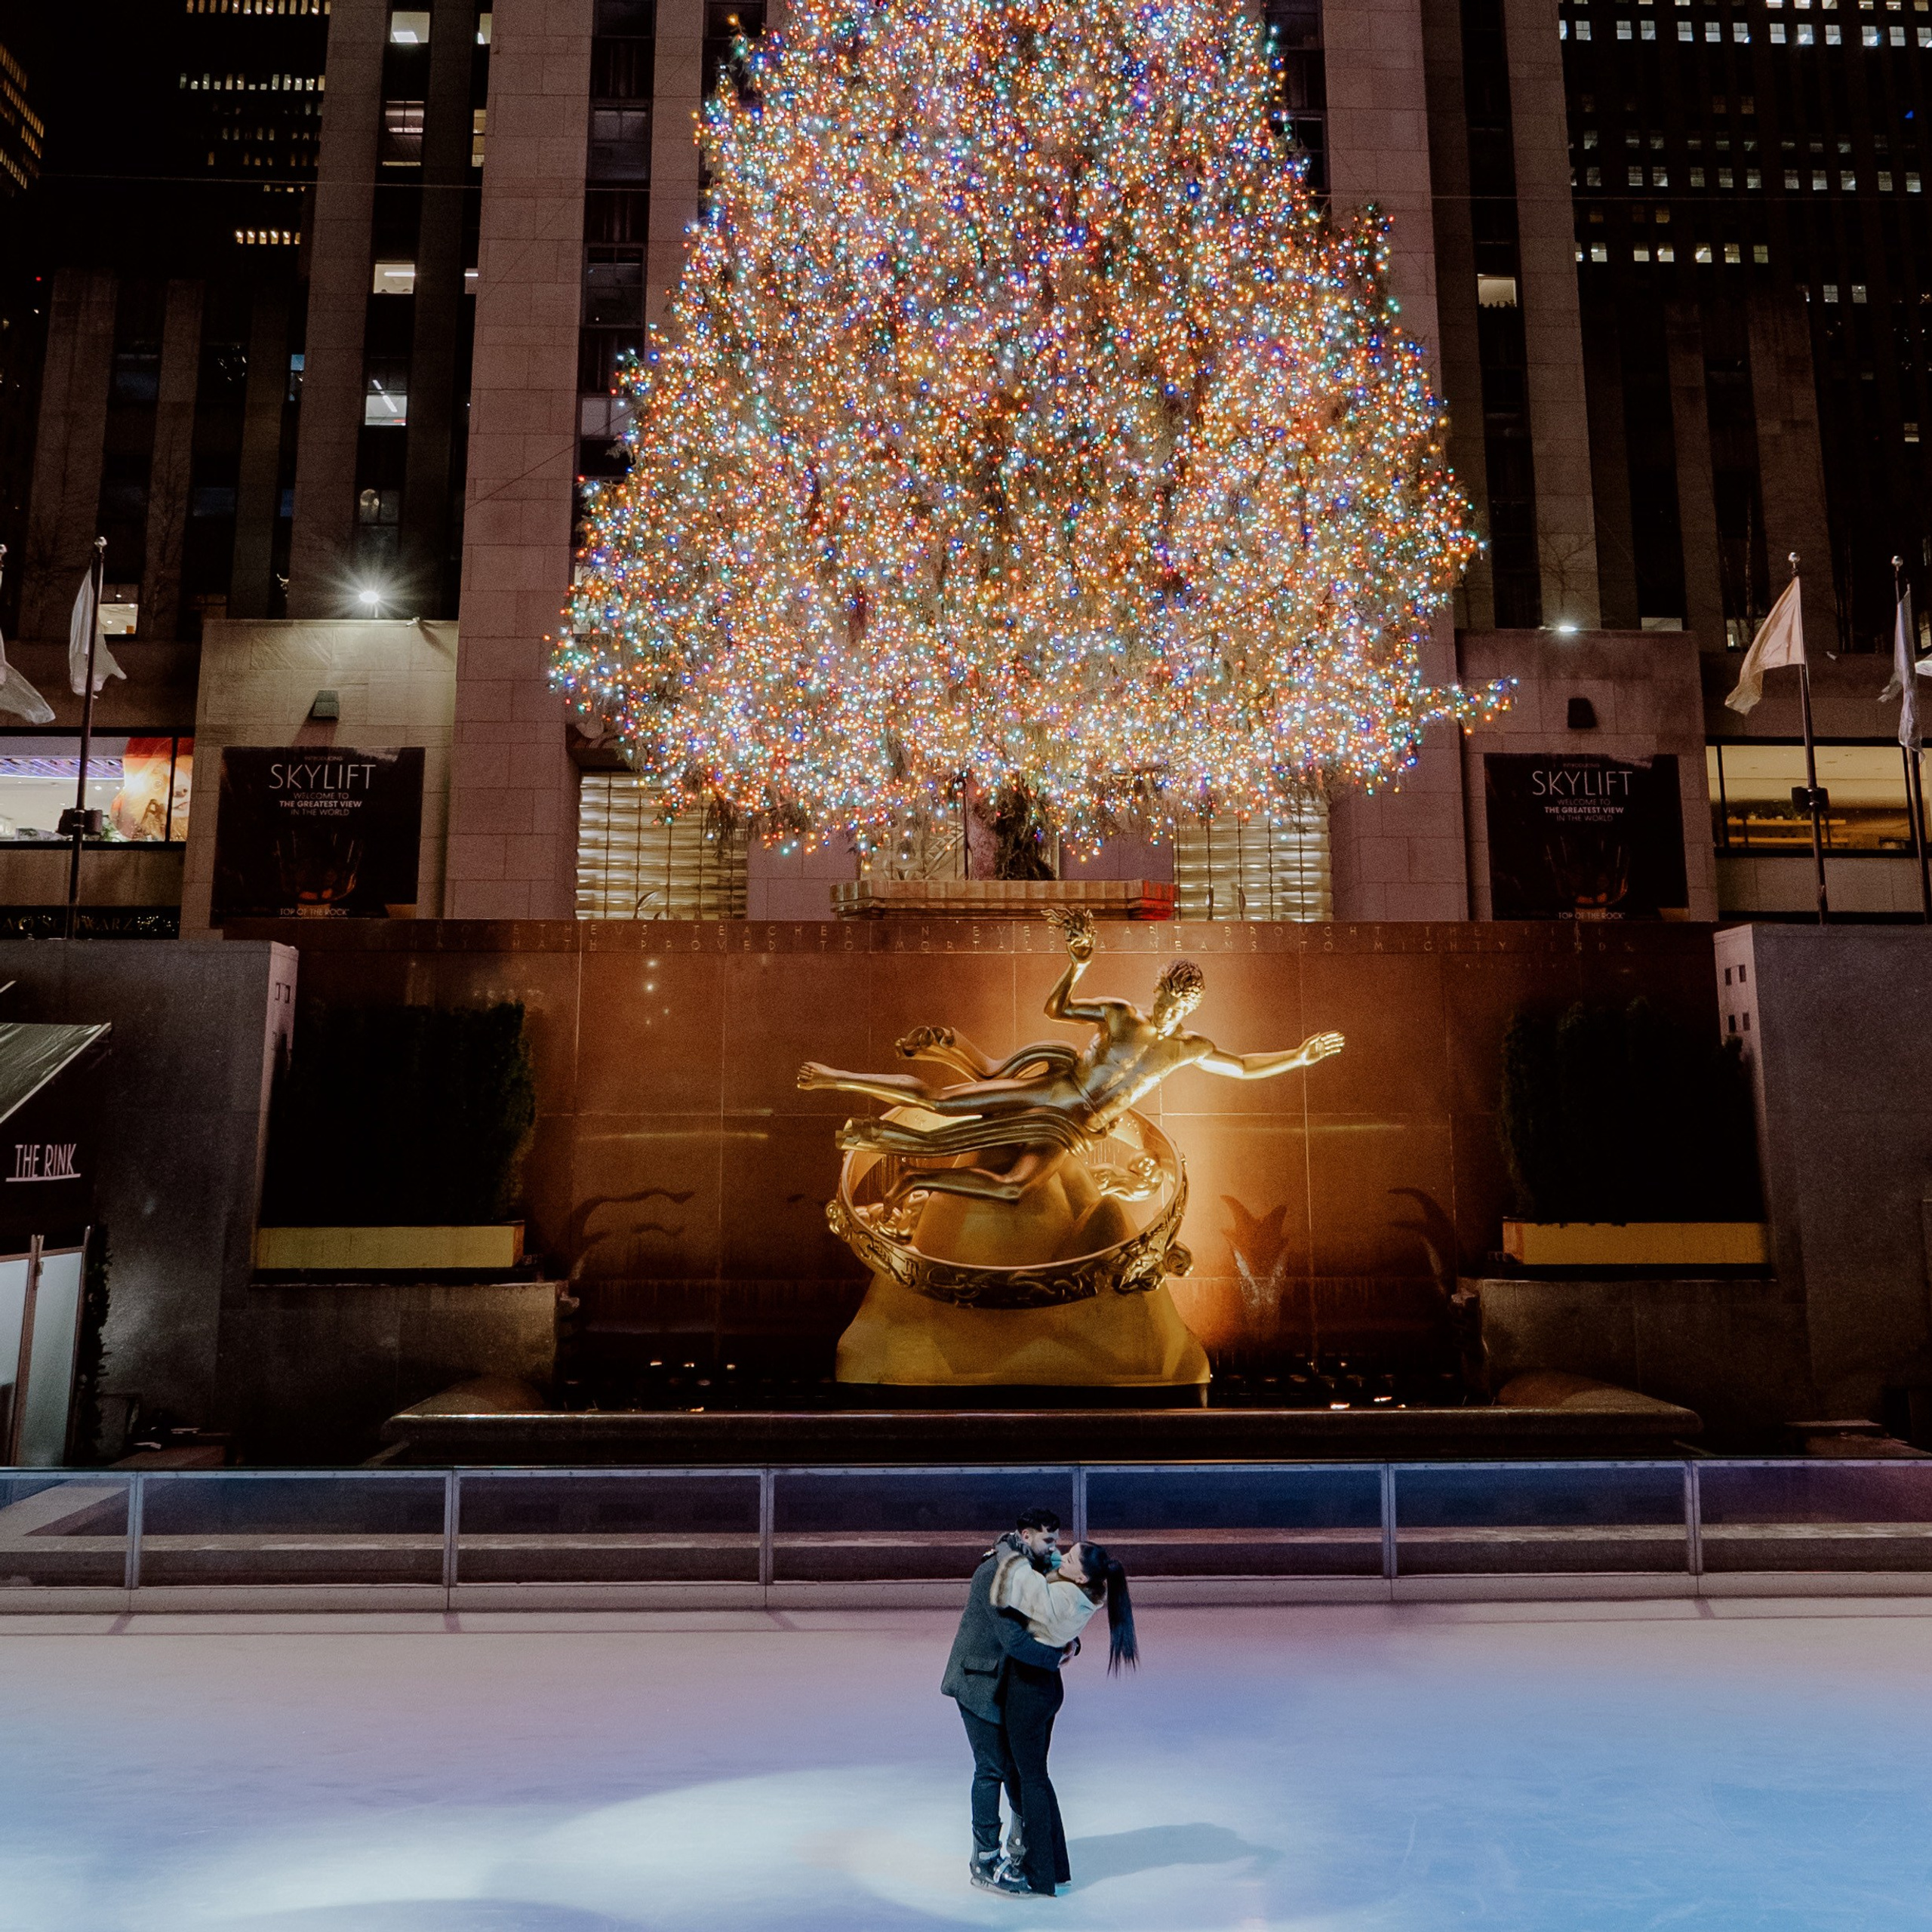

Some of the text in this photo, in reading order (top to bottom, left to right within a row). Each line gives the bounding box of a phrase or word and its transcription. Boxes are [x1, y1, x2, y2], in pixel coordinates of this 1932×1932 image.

[269, 764, 377, 789] SKYLIFT
[1532, 771, 1633, 795] SKYLIFT
[280, 908, 295, 916] TOP
[38, 916, 134, 931] SCWARZ
[693, 924, 853, 937] TEACHER
[898, 925, 930, 937] IN
[1124, 926, 1182, 937] ART
[641, 940, 776, 951] PROVED
[820, 940, 854, 951] TO
[896, 940, 1055, 951] MORTALS
[1149, 940, 1257, 951] MEANS
[1300, 940, 1334, 951] TO
[1374, 940, 1506, 951] MIGHTY
[15, 1143, 77, 1177] THE RINK
